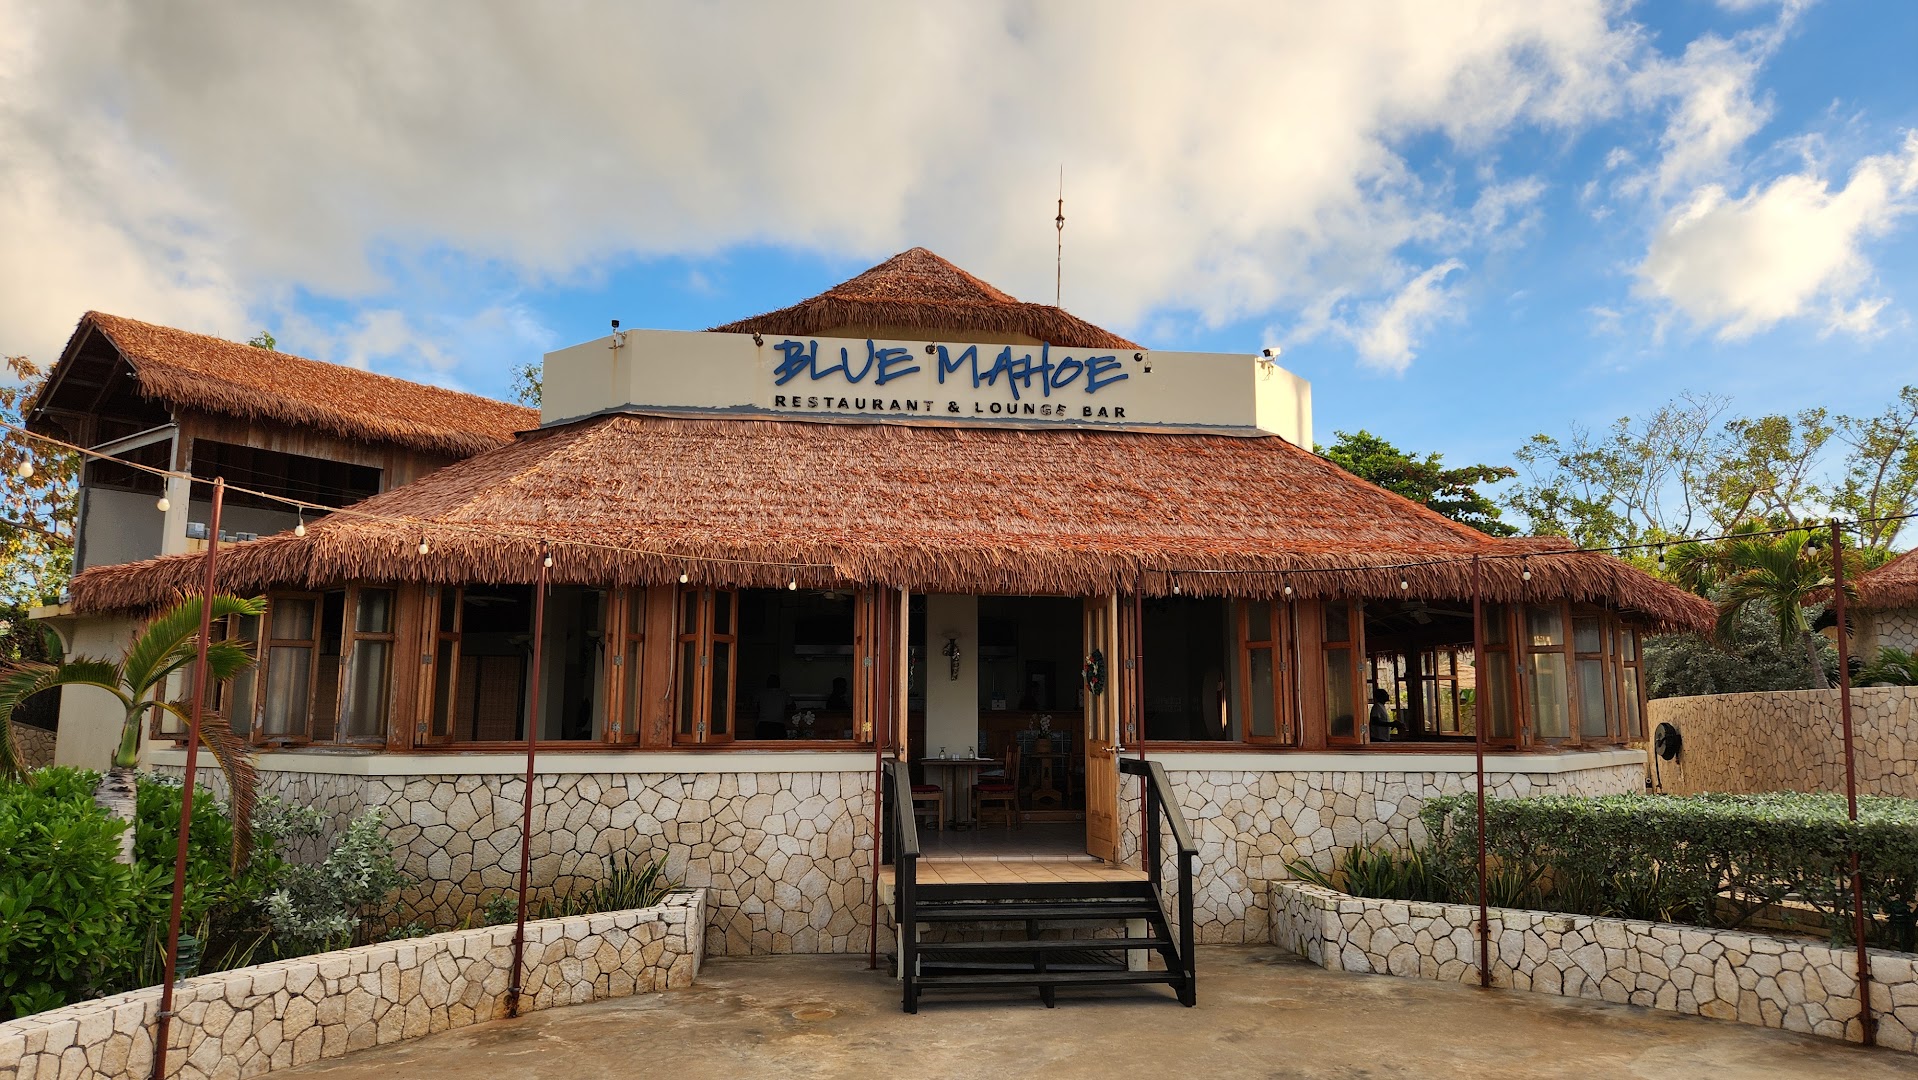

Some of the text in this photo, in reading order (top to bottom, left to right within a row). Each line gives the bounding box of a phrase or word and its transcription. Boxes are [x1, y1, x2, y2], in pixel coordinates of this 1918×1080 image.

[774, 339, 1129, 401] BLUE MAHOE
[775, 395, 1126, 418] RESTAURANT & LOUNGE BAR
